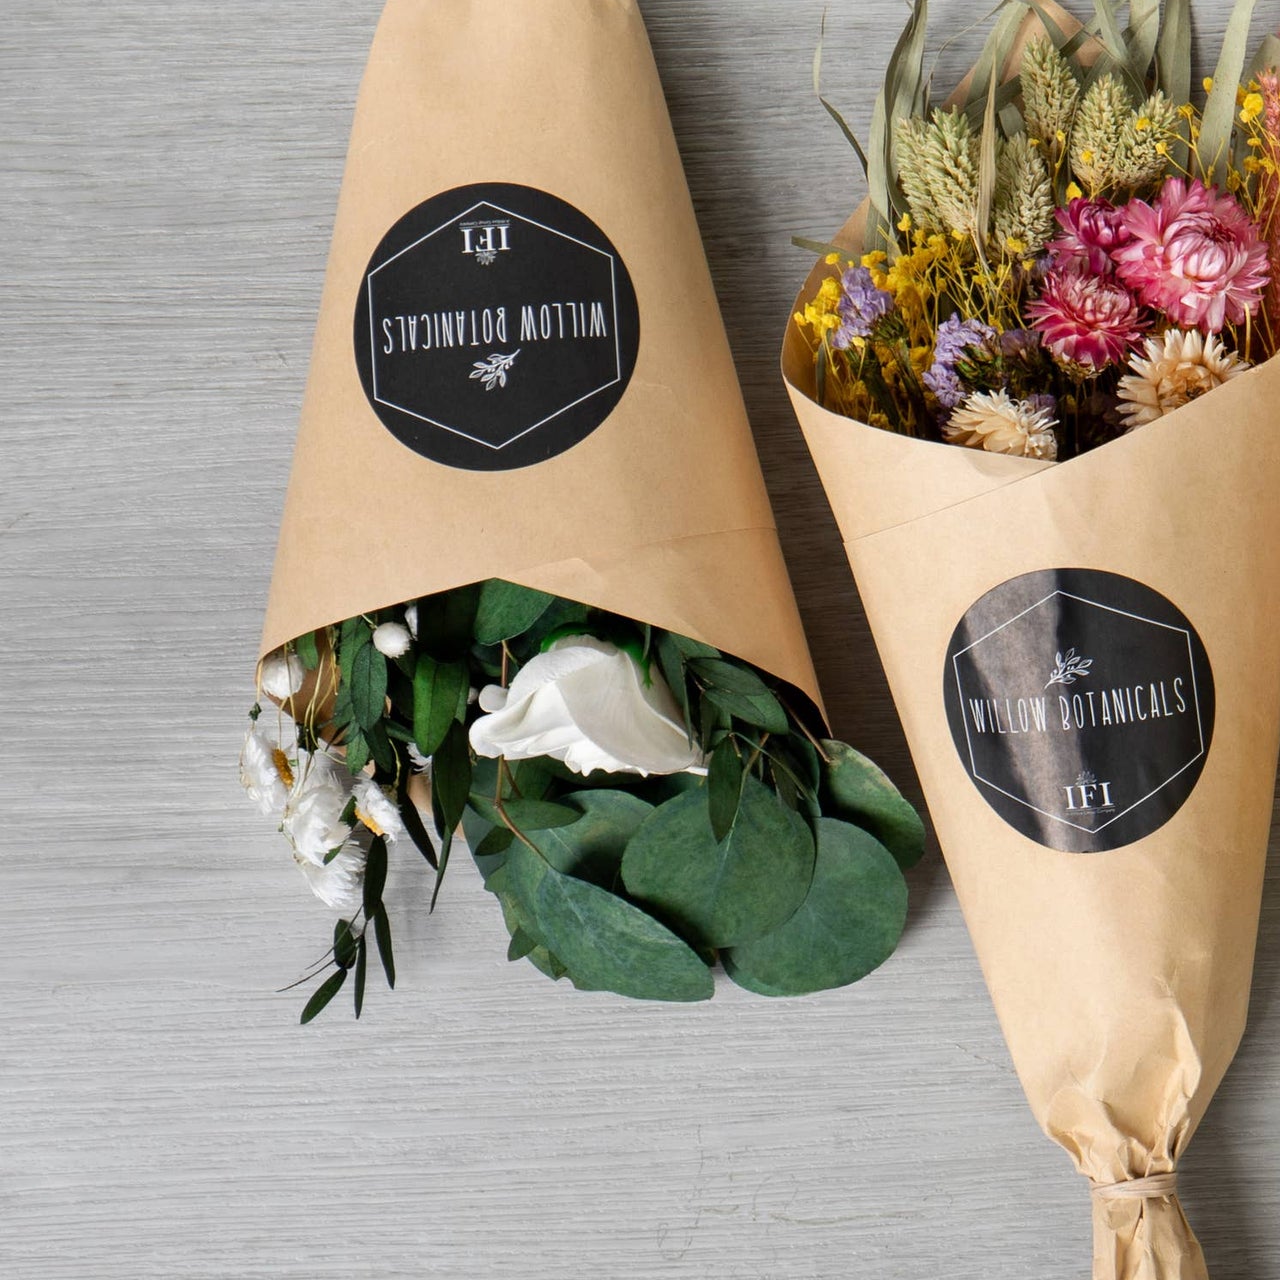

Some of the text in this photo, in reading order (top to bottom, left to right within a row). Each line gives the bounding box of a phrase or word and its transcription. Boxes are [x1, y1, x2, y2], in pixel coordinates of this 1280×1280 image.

[461, 225, 511, 253] IFI
[382, 302, 607, 354] WILLOW BOTANICALS
[969, 677, 1186, 734] WILLOW BOTANICALS
[1063, 782, 1114, 810] IFI
